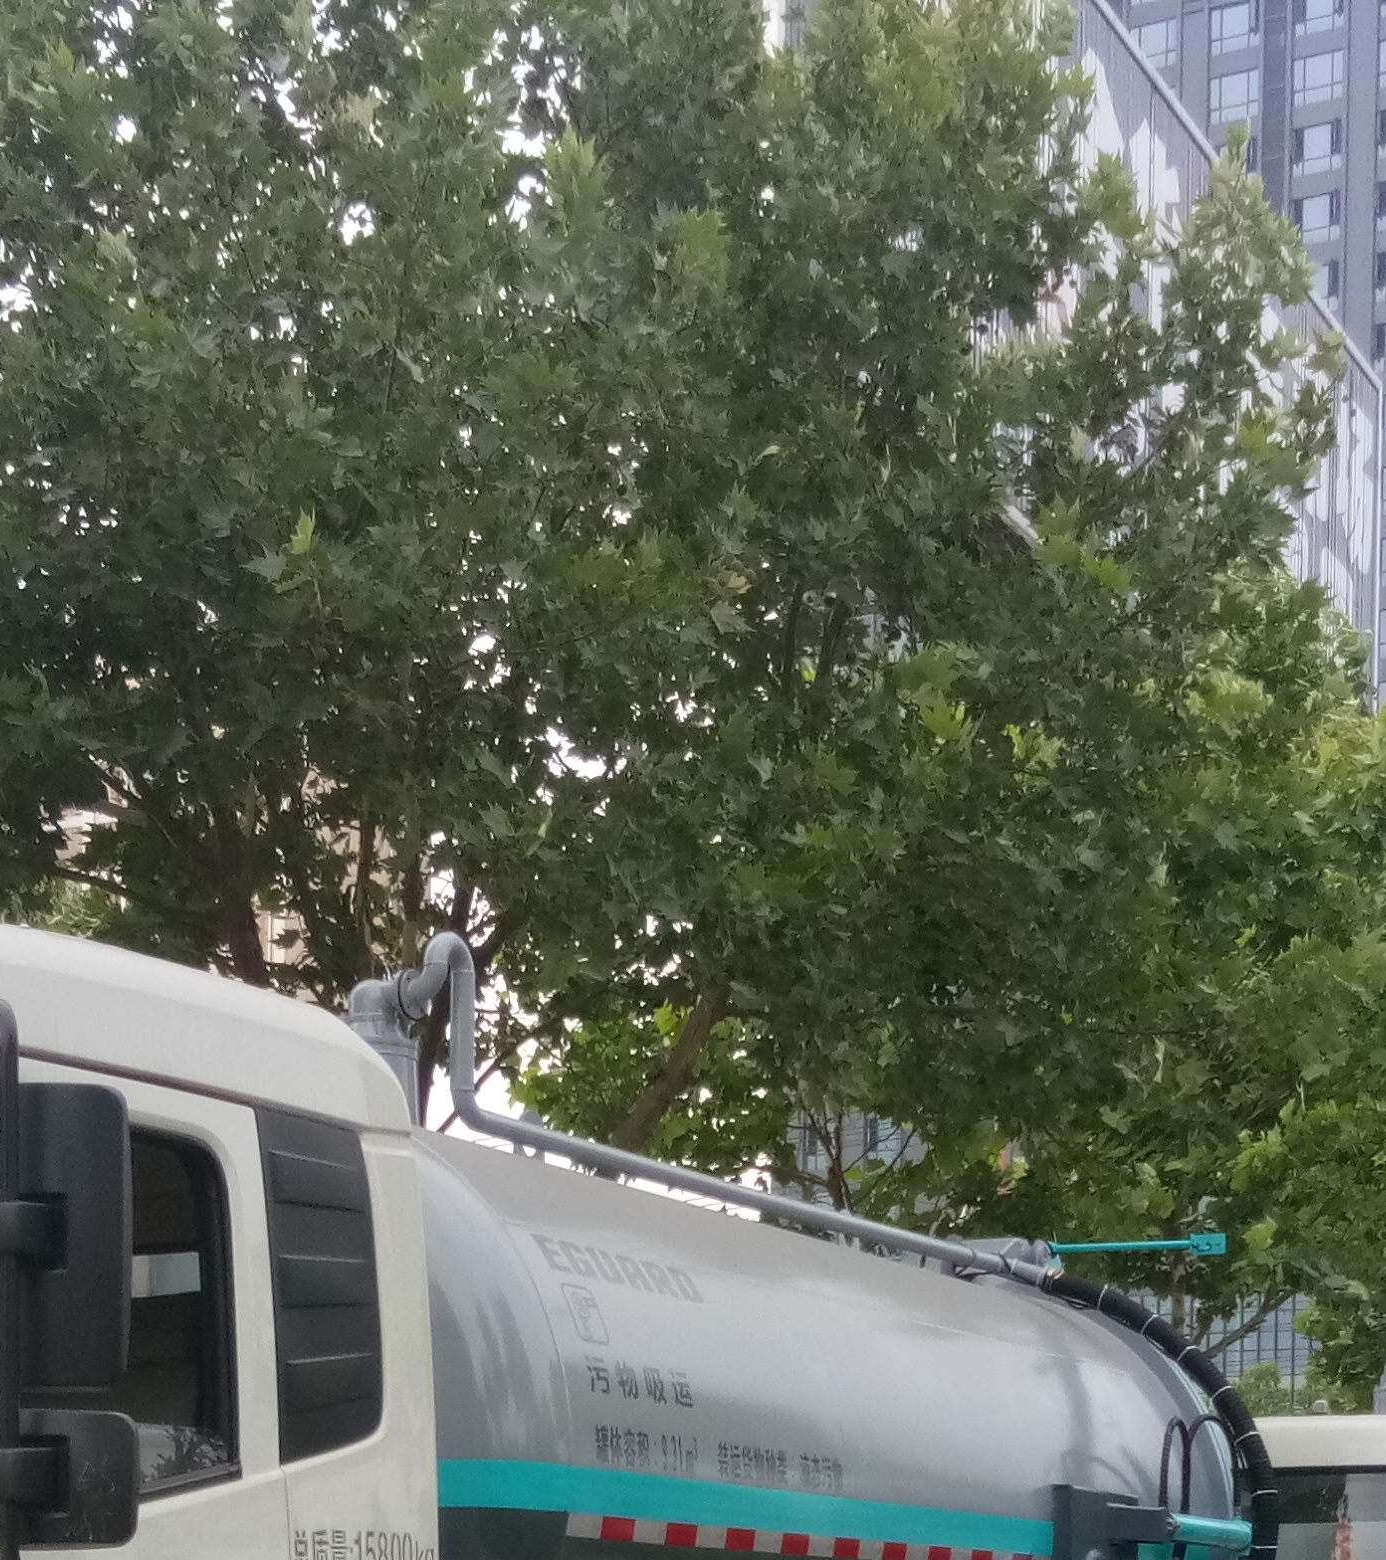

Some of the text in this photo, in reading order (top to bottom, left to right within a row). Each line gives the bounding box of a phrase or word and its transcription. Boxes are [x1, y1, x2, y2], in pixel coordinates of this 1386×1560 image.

[530, 1233, 704, 1304] EGUARD
[585, 1355, 694, 1409] 污物吸运
